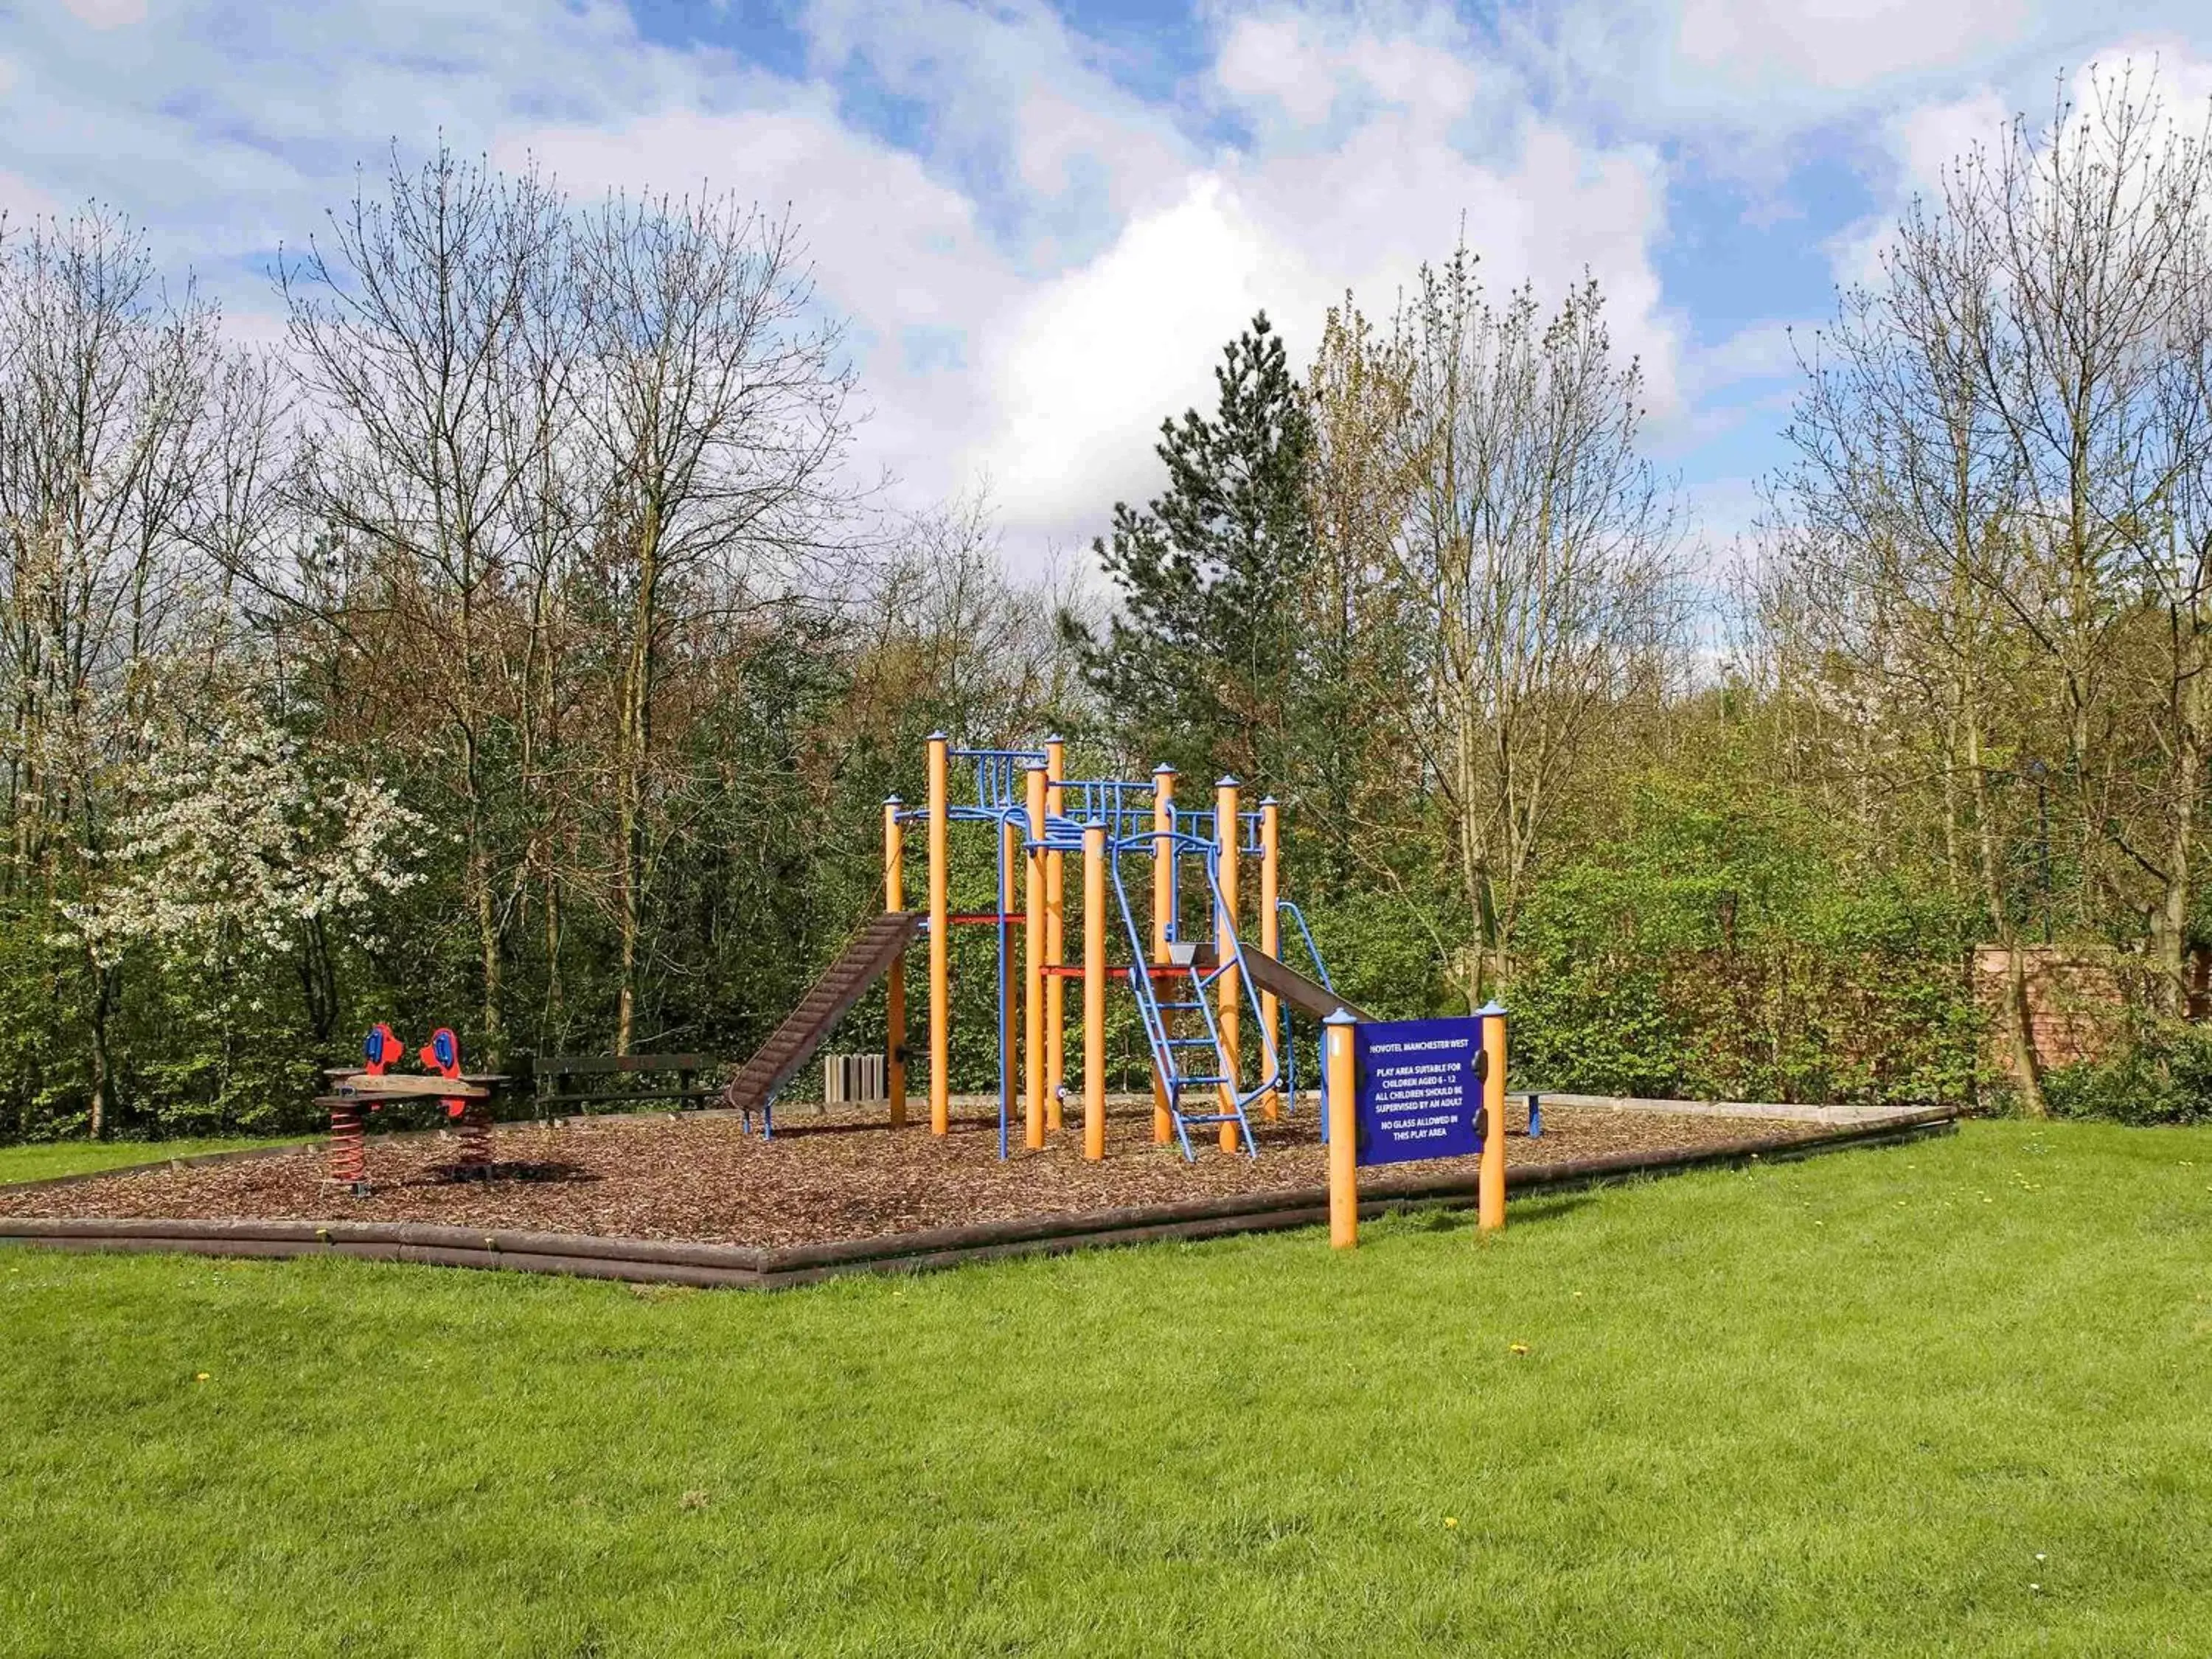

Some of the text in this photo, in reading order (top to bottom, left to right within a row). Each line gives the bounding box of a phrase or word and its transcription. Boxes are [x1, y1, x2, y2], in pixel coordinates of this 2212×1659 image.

[1370, 1039, 1469, 1053] NOVOTEL MANCHESTER WEST
[1377, 1062, 1461, 1077] PLAY AREA SUITABLE FOR
[1382, 1078, 1417, 1088] CHILDREN
[1419, 1077, 1437, 1085] AGED
[1448, 1075, 1455, 1083] 12
[1376, 1086, 1462, 1101] ALL CHILDREN SHOULD BE
[1376, 1097, 1462, 1113] SUPERVISED BY AN ADULT
[1381, 1121, 1392, 1130] NO
[1394, 1119, 1416, 1129] GLASS
[1416, 1116, 1450, 1127] ALLOWED
[1394, 1128, 1447, 1141] THIS PLAY AREA
